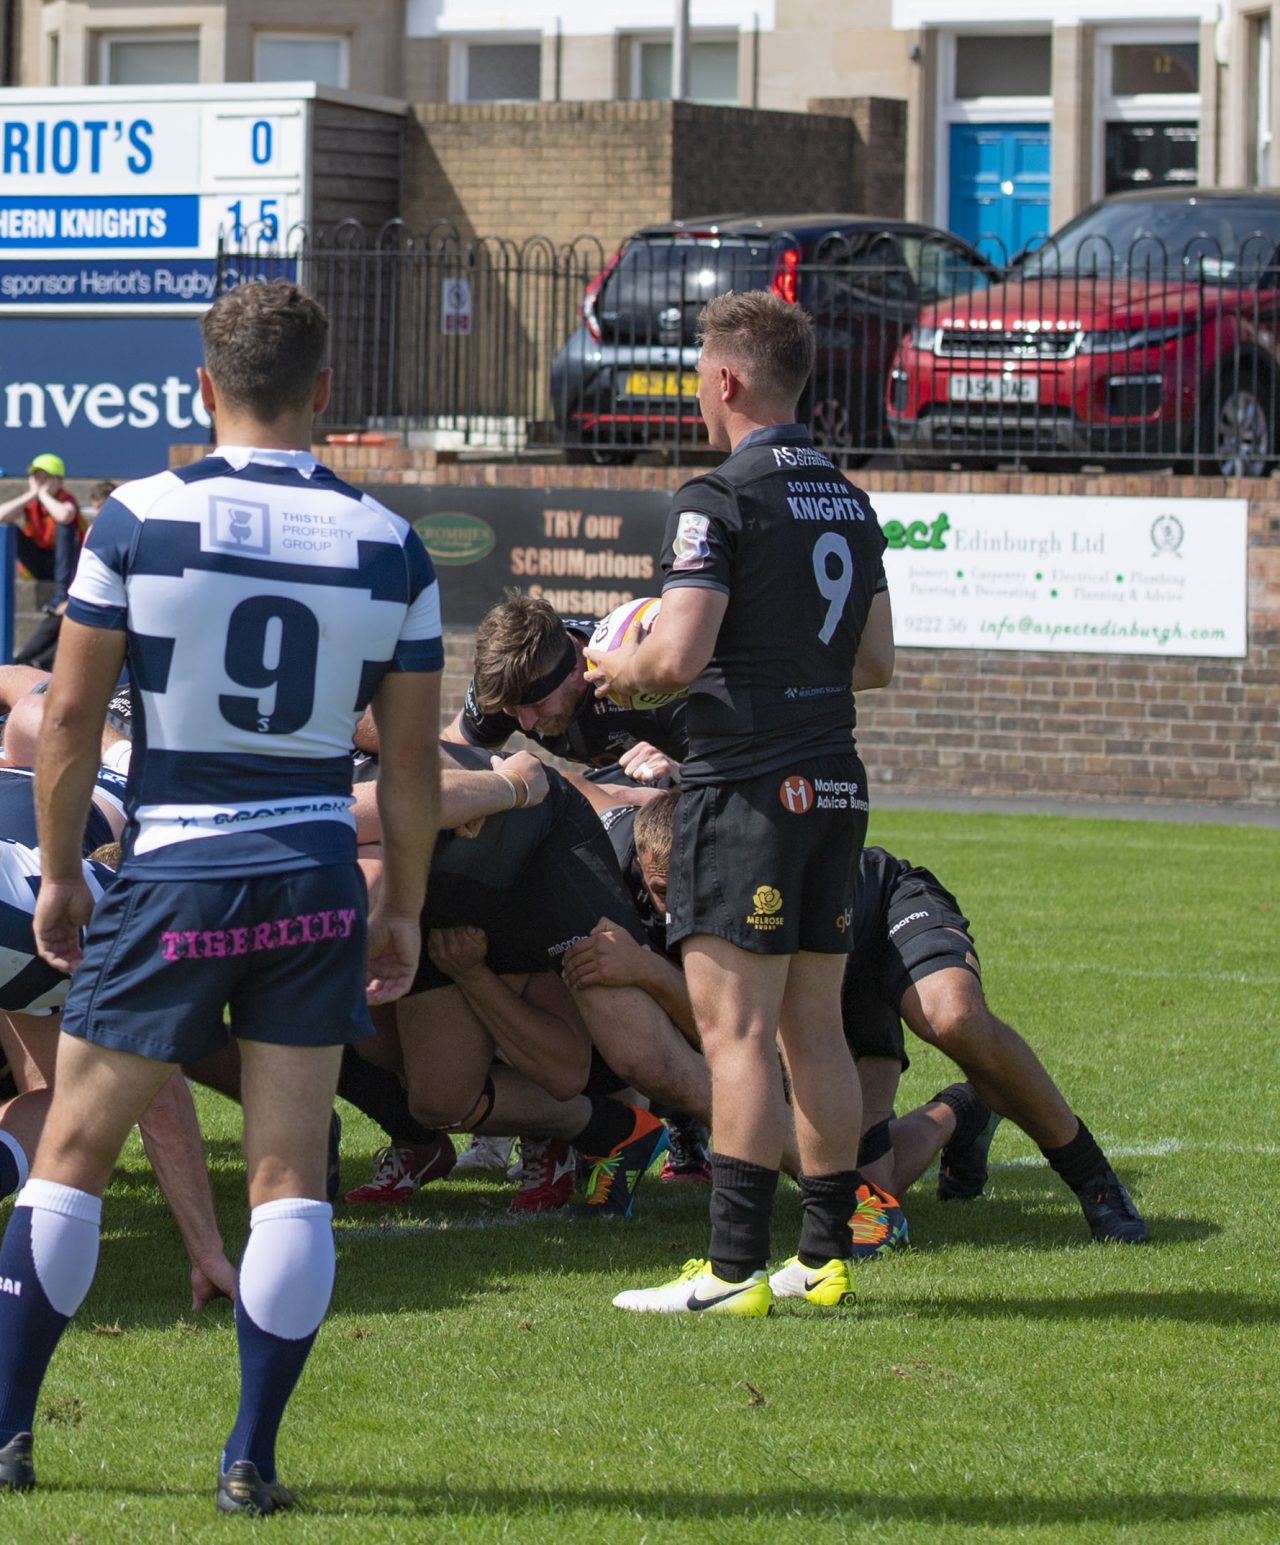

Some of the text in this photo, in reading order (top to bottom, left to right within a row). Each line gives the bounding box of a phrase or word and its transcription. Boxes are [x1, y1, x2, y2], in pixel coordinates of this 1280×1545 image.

[251, 120, 273, 165] 0
[60, 207, 167, 239] KNIGHTS
[2, 274, 78, 299] sponsor
[81, 270, 151, 294] Heriot's
[154, 269, 218, 299] Rugby
[787, 481, 849, 495] SOUTHERN
[282, 512, 337, 526] THISTLE
[787, 496, 865, 521] KNIGHTS
[282, 525, 354, 540] PROPERTY
[543, 509, 623, 540] TRY our
[881, 512, 1106, 556] ect Edinburgh Ltd
[282, 538, 332, 552] GROUP
[510, 547, 655, 580] SCRUMptious
[812, 531, 853, 647] 9
[980, 614, 1227, 647] info@aspectedinburgh.com
[218, 594, 320, 735] 9
[816, 796, 848, 809] Advice
[160, 909, 357, 961] TIGERLILY
[746, 915, 785, 926] MELROSE
